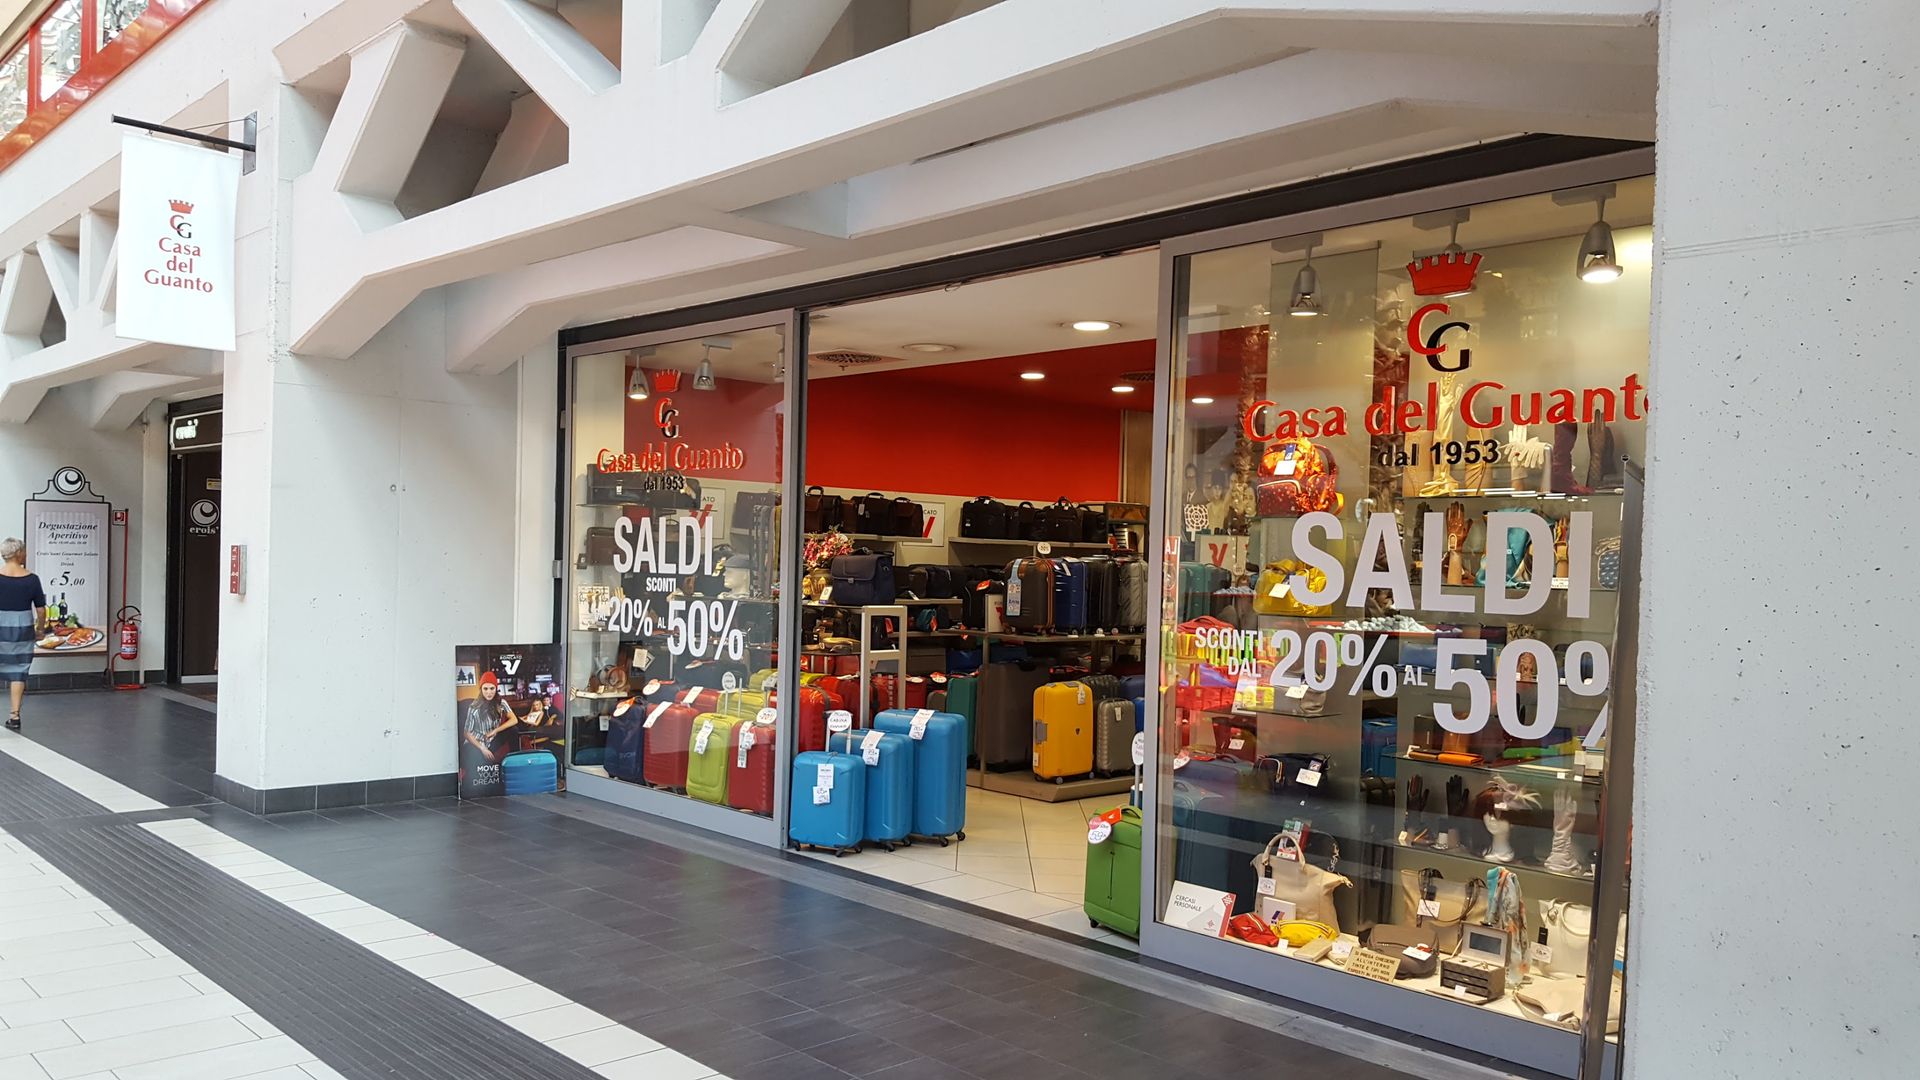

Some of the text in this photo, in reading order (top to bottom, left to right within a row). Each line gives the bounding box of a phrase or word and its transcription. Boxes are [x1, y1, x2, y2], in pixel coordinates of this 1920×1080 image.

[159, 237, 201, 257] Casa
[166, 255, 193, 273] del
[144, 268, 213, 293] Guanto
[1242, 373, 1649, 443] Casa del Guant
[597, 441, 744, 473] Casa del Guanto
[1378, 439, 1499, 468] dal 1953
[644, 475, 684, 491] dal 1953
[38, 521, 98, 531] Degustazione
[48, 532, 88, 540] Aperitivo
[613, 516, 713, 576] SALDI
[1289, 511, 1593, 619] SALDI
[646, 577, 676, 593] SCONTI
[608, 596, 652, 637] 20%
[657, 618, 666, 629] AL
[667, 600, 744, 660] 50%
[1195, 626, 1263, 651] SCONTI
[1227, 656, 1261, 677] DAL
[1269, 629, 1398, 699] 20%
[1403, 664, 1428, 687] AL
[477, 764, 499, 772] MOVE
[472, 777, 500, 786] DREAM
[1174, 900, 1201, 911] PERSONALE
[1175, 894, 1197, 904] CERCASI
